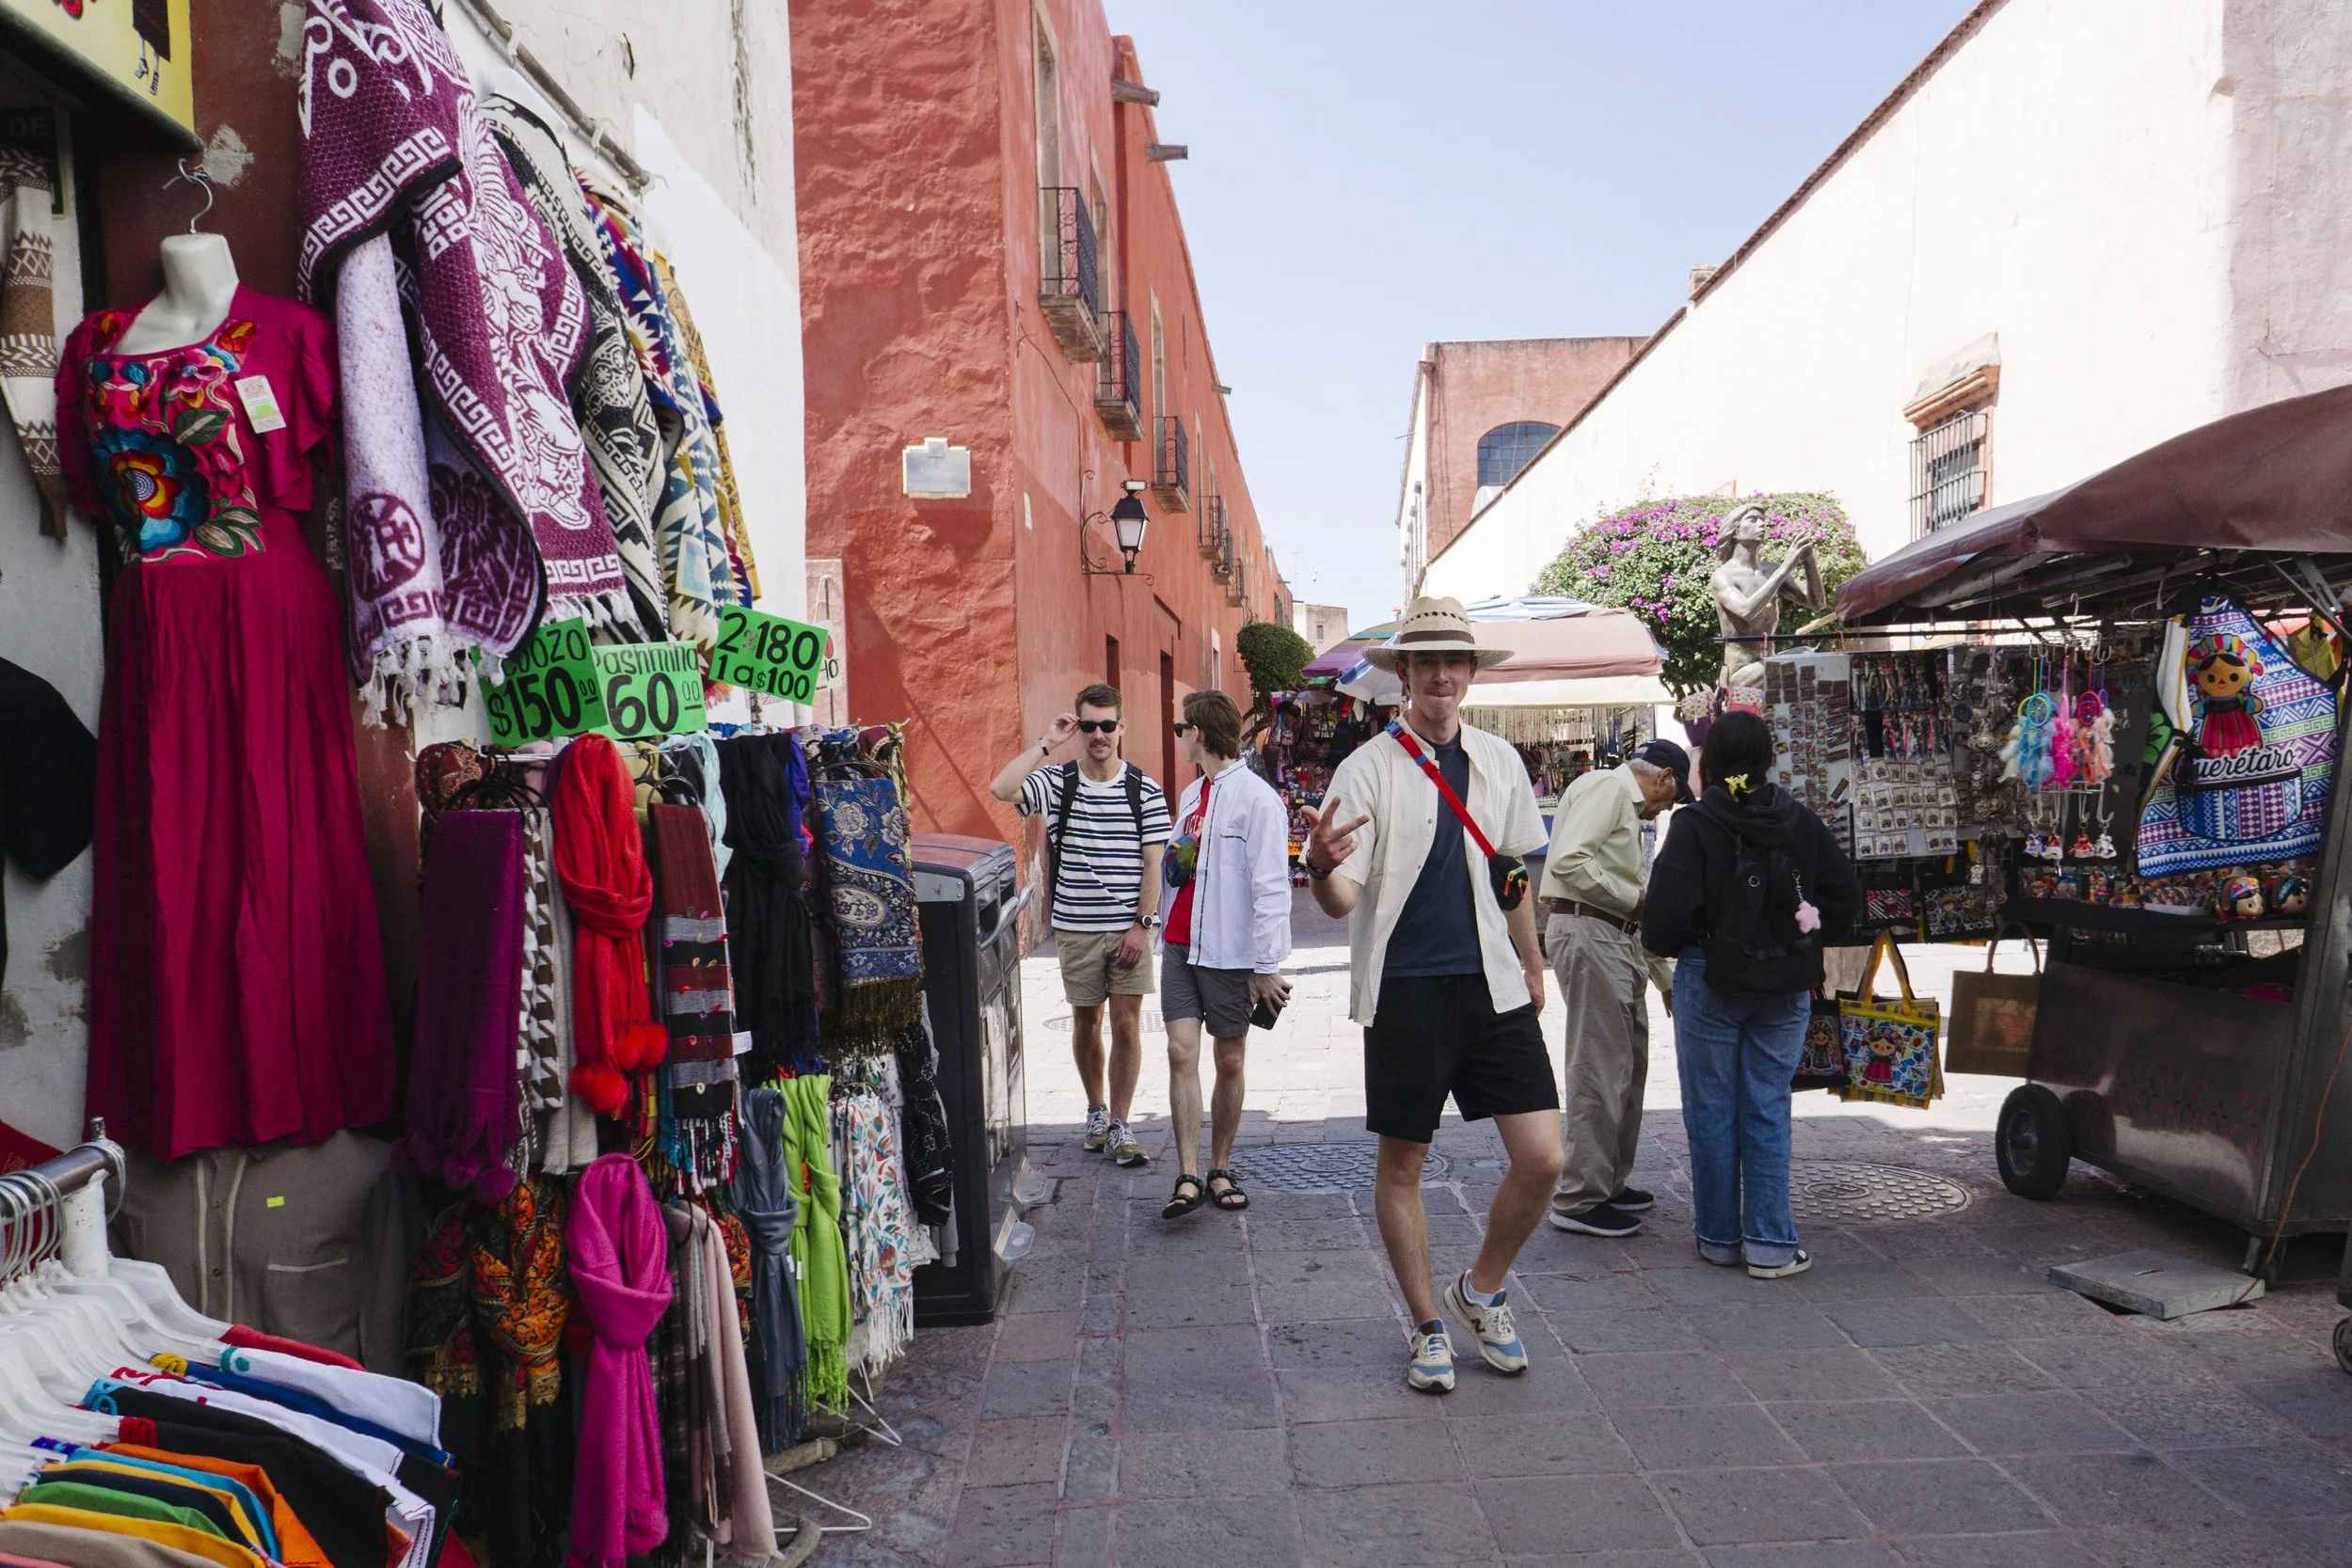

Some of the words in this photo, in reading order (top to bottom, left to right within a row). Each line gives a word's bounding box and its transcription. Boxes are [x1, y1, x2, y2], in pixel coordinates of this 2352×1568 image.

[716, 611, 748, 654] 2
[755, 620, 820, 671] 180
[486, 666, 581, 739] $150
[606, 672, 679, 736] 60
[755, 666, 810, 700] $100
[2171, 747, 2296, 784] uerétaro
